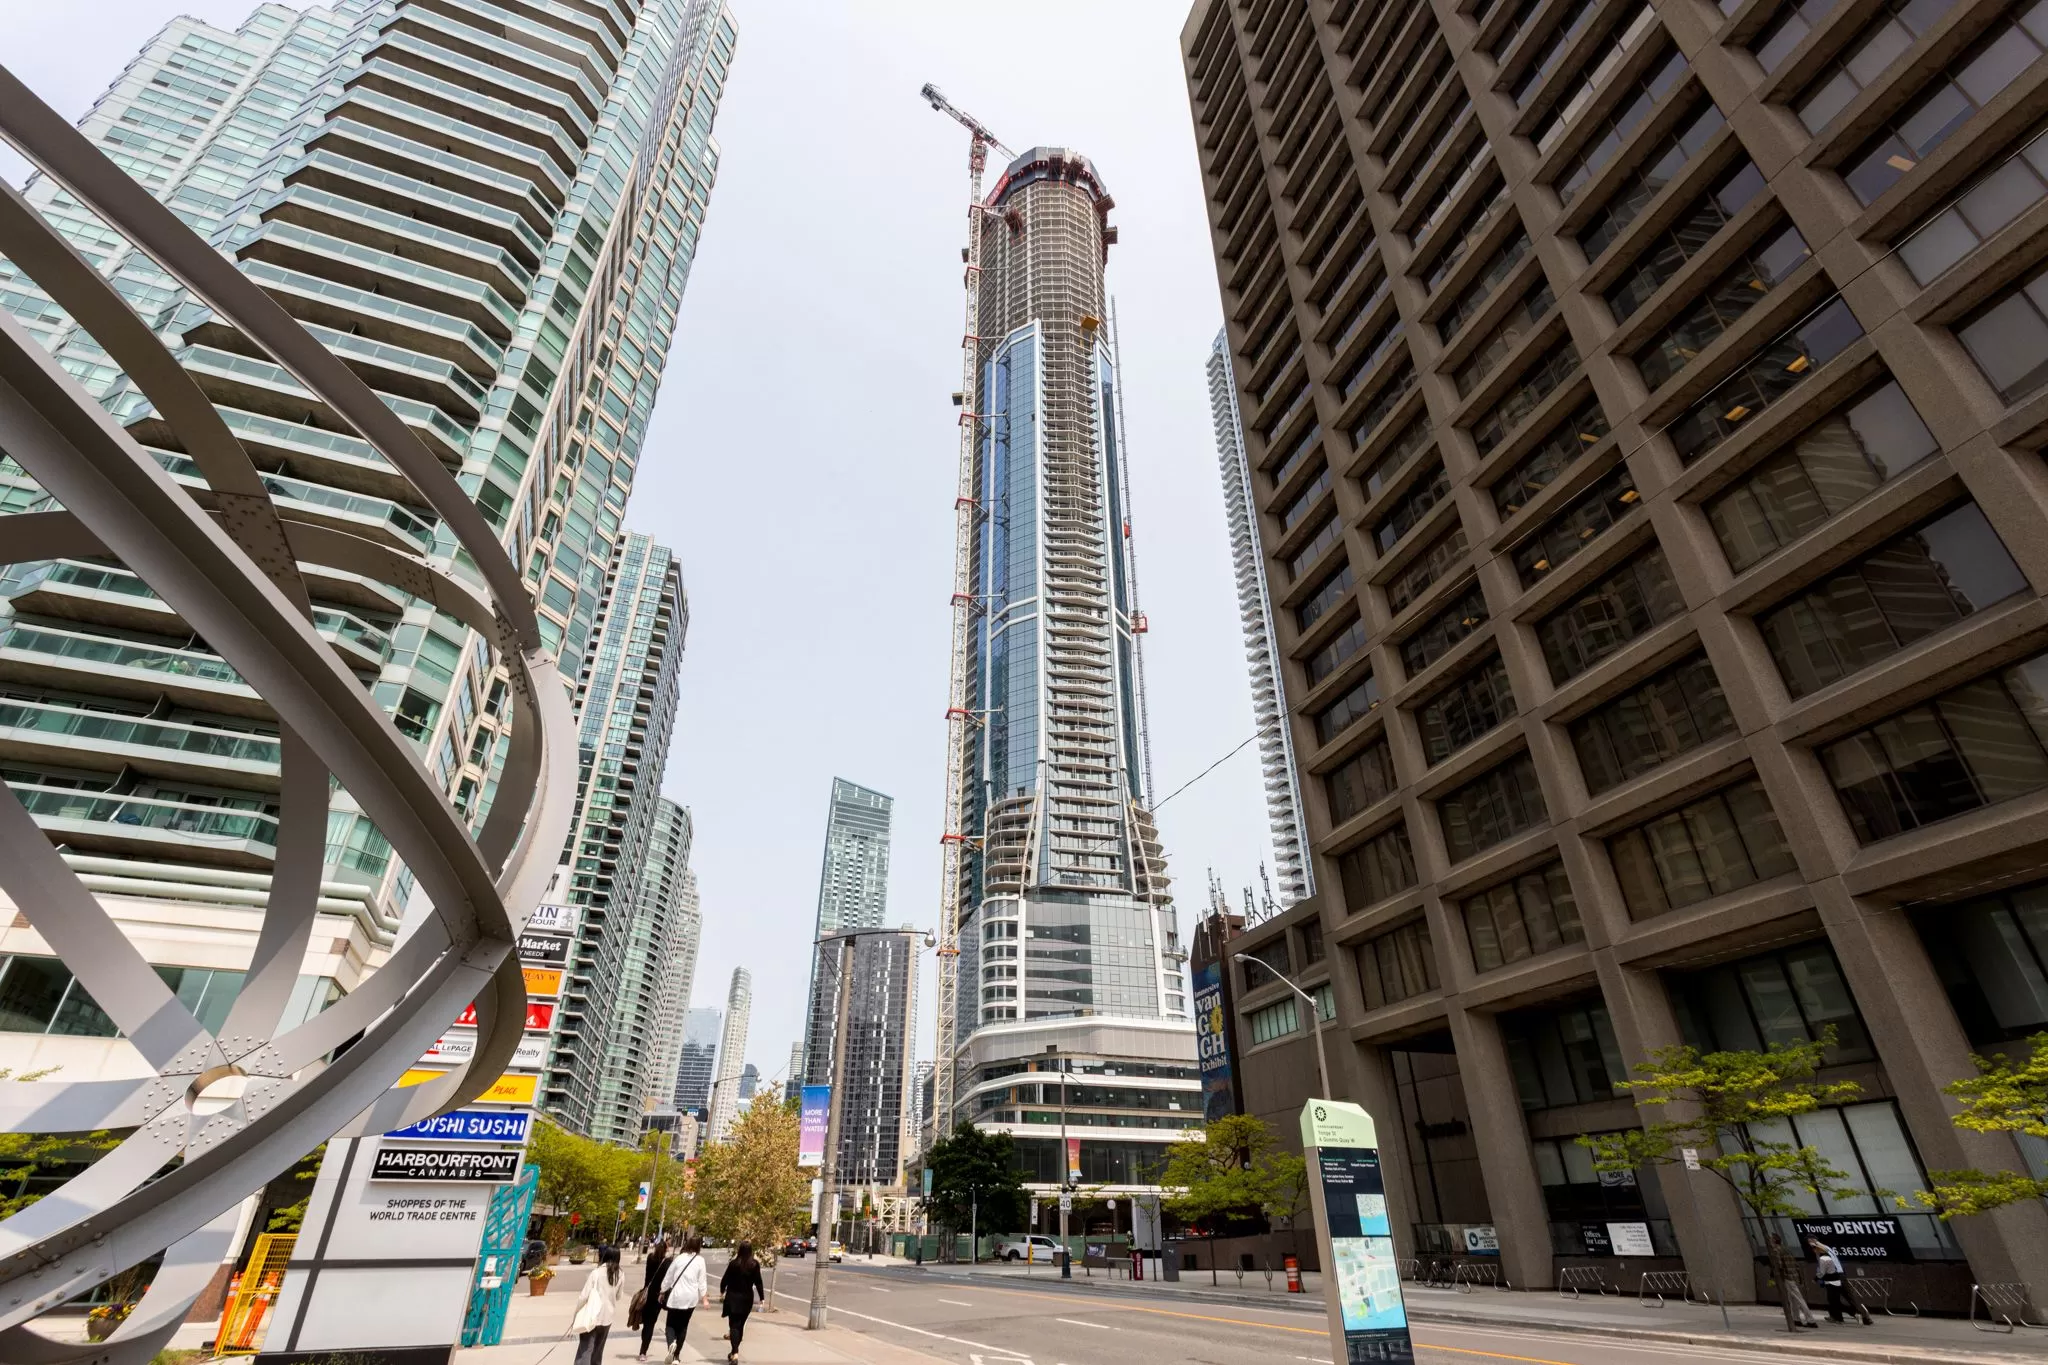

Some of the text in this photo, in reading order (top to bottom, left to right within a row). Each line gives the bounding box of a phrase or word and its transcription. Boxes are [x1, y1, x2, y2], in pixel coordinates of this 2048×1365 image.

[521, 938, 562, 951] Market
[1194, 982, 1219, 998] Immersive
[1196, 991, 1221, 1013] van
[1200, 1031, 1226, 1059] GH
[516, 1048, 541, 1057] Realty
[1202, 1055, 1227, 1072] Exhibit
[413, 1117, 525, 1136] OYSHI SUSHI
[379, 1152, 516, 1169] HARBOURFRONT
[408, 1168, 482, 1177] CANNABIS
[387, 1199, 466, 1209] SHOPPES OF THE
[1061, 1200, 1070, 1208] 40
[370, 1211, 477, 1220] WORLD TRADE CENTRE
[1804, 1223, 1832, 1235] Yonge
[1833, 1221, 1896, 1234] DENTIST
